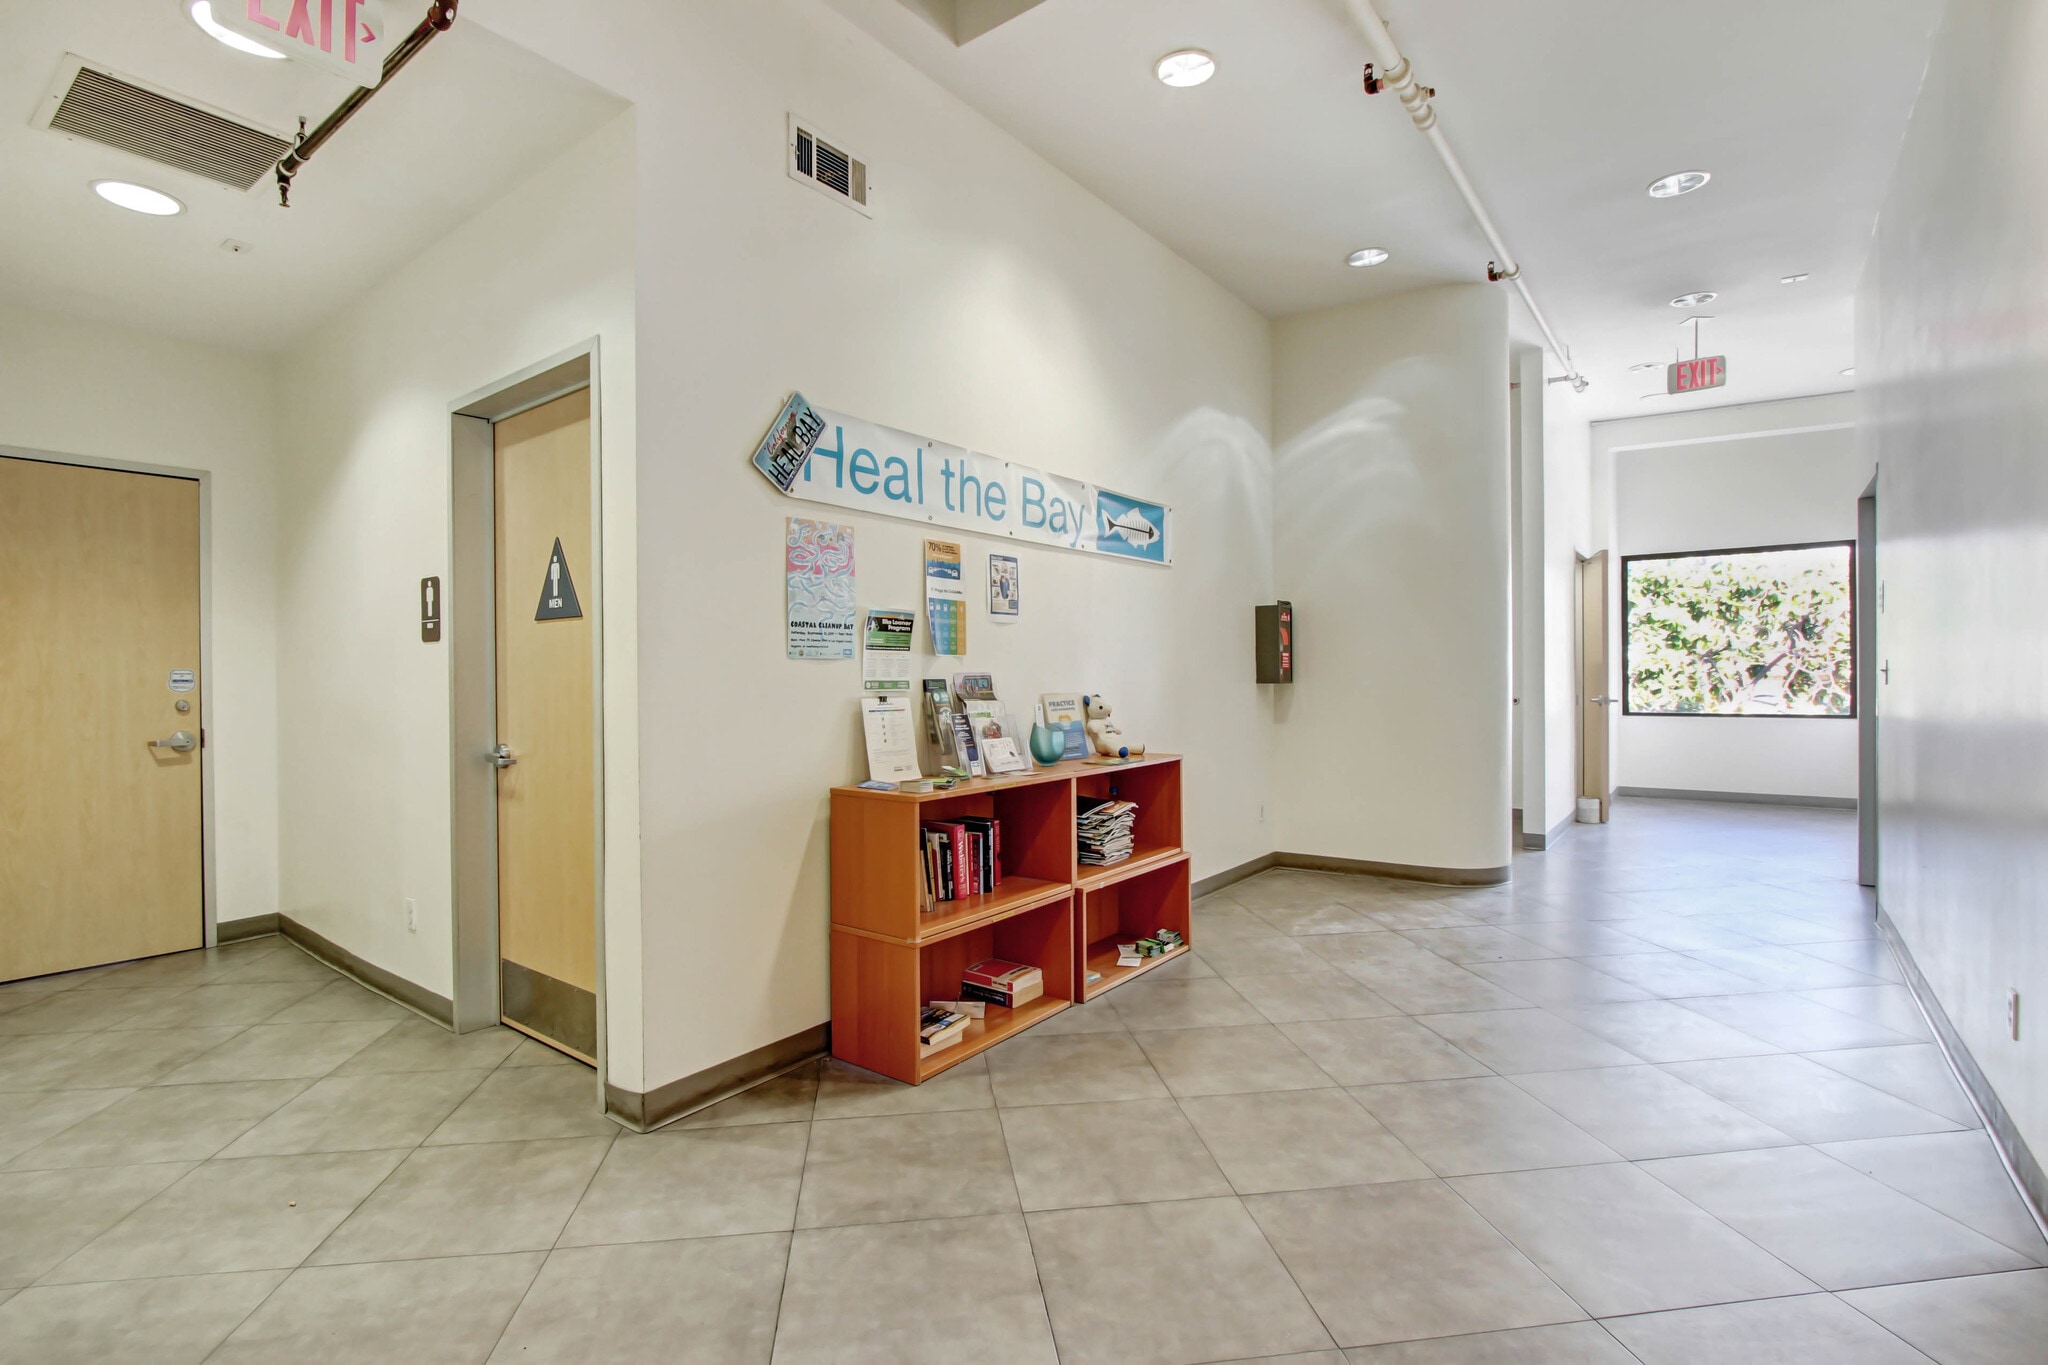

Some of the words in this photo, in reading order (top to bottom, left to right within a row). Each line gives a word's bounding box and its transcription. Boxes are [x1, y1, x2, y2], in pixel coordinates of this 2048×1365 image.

[248, 0, 365, 63] XIT
[1677, 358, 1719, 390] EXIT
[767, 412, 799, 455] California
[768, 441, 805, 486] HEAL
[793, 407, 821, 446] BAY
[804, 426, 923, 505] Heal
[941, 458, 1007, 522] the
[1022, 476, 1086, 548] Bay
[928, 541, 942, 552] 70%
[549, 598, 563, 608] MEN
[892, 619, 912, 627] Loaner
